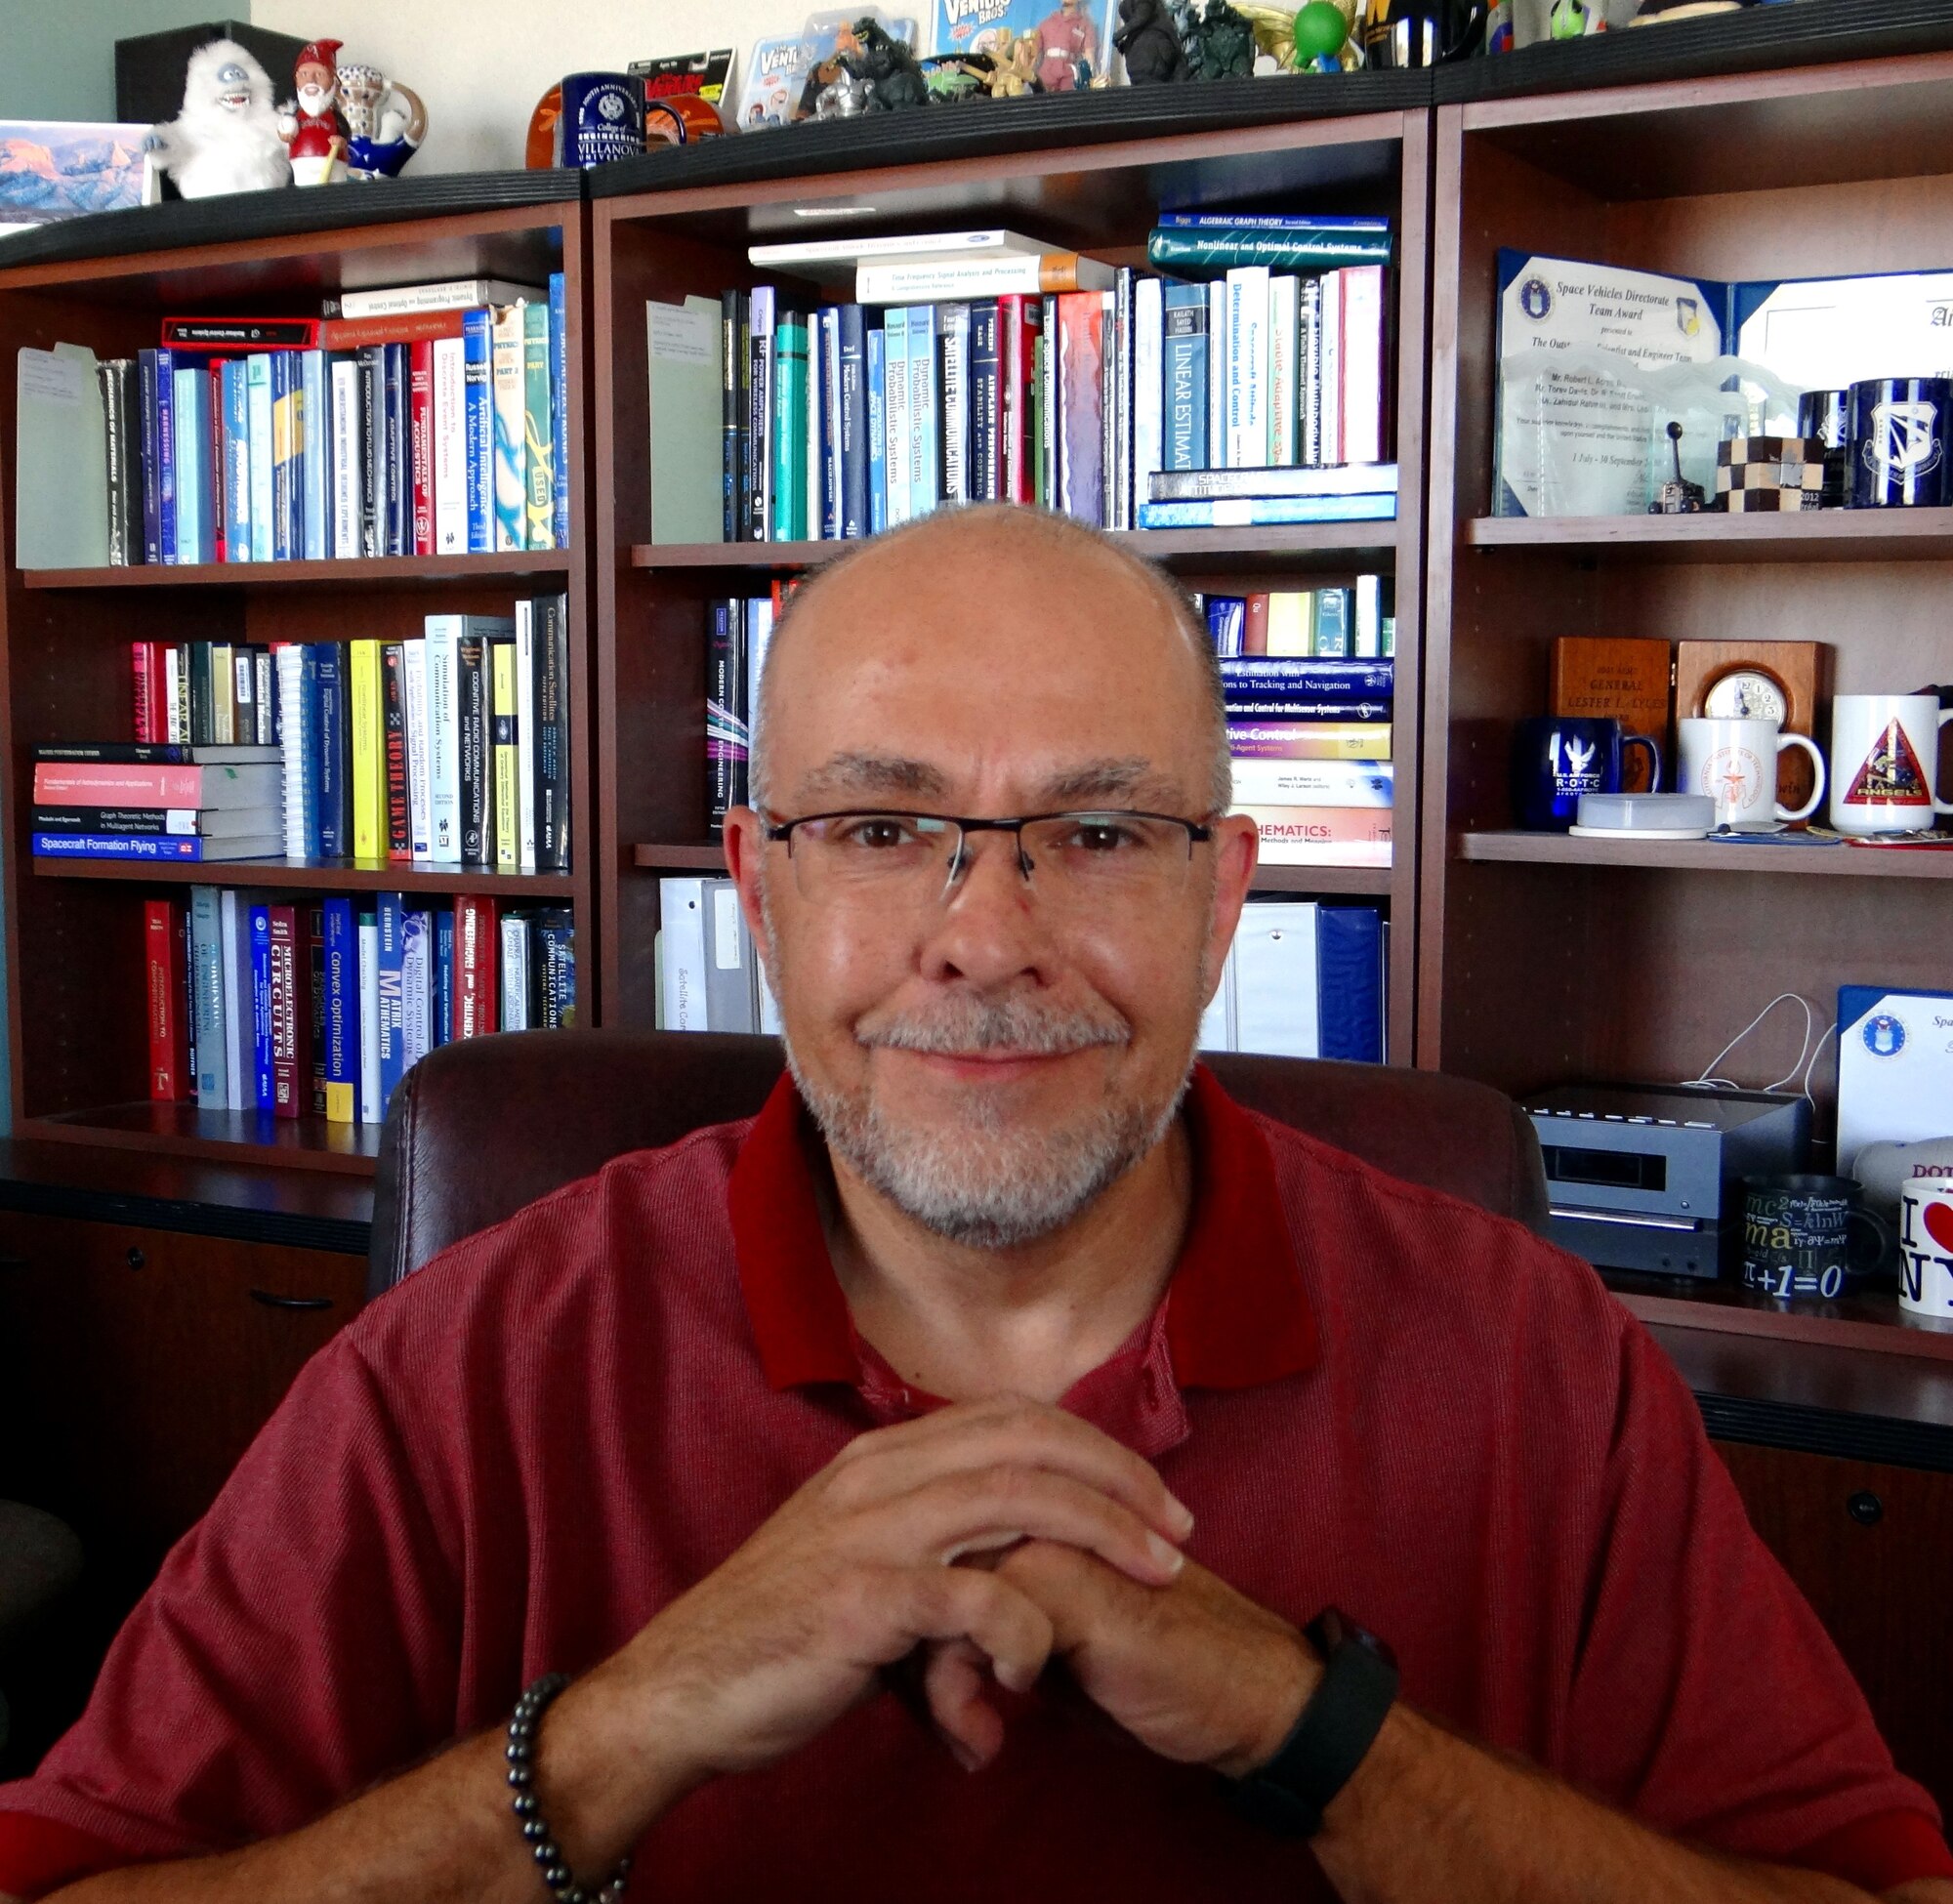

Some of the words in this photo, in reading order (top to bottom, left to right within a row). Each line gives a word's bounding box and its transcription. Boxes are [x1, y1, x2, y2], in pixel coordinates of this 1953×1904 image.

[598, 122, 618, 133] College
[619, 124, 627, 134] of
[1175, 216, 1190, 226] Biggs
[1199, 216, 1233, 226] ALGEBRAIC
[1234, 217, 1257, 227] GRAPH
[1258, 218, 1283, 227] THEORY
[1197, 239, 1238, 251] Nonlinear
[1240, 242, 1254, 251] and
[1257, 241, 1288, 253] Optimal
[1292, 242, 1324, 252] Control
[1327, 243, 1362, 255] Systems
[907, 272, 935, 282] Frequency
[937, 270, 955, 280] Signal
[957, 269, 979, 278] Analysis
[994, 268, 1025, 277] Processing
[1557, 281, 1585, 297] Space
[1587, 285, 1623, 301] Vehicles
[1625, 289, 1670, 307] Directorate
[1043, 315, 1052, 342] Laser
[1231, 283, 1242, 362] Determination
[1590, 304, 1612, 316] Team
[1615, 308, 1643, 320] Award
[759, 340, 768, 357] RF
[1042, 344, 1052, 371] Space
[1532, 336, 1547, 348] The
[1628, 347, 1641, 357] and
[1642, 349, 1674, 361] Engineer
[1675, 352, 1692, 362] Team
[466, 374, 486, 383] Norvig
[921, 359, 930, 408] Dynamic
[943, 336, 959, 392] SATELLITE
[1175, 344, 1192, 399] LINEAR
[1231, 365, 1241, 385] and
[1552, 373, 1561, 382] Mr.
[1564, 374, 1587, 384] Robert
[106, 369, 118, 420] MECHANICS
[843, 393, 852, 419] Control
[888, 361, 897, 431] Probabilistic
[896, 361, 906, 410] Dynamic
[912, 359, 922, 432] Probabilistic
[108, 422, 117, 434] OF
[449, 423, 457, 433] to
[478, 396, 487, 448] Artificial
[1043, 374, 1052, 448] Communications
[1231, 389, 1242, 428] Control
[468, 410, 478, 456] Modern
[842, 421, 851, 452] Systems
[944, 396, 961, 494] COMMUNICATIONS
[1175, 404, 1192, 470] ESTIMAT
[109, 435, 118, 482] MATERIALS
[440, 435, 449, 478] Systems
[888, 434, 897, 484] Systems
[912, 435, 922, 483] Systems
[1578, 453, 1593, 465] July
[1600, 454, 1608, 463] 30
[1610, 454, 1642, 468] September
[467, 459, 478, 511] Approach
[478, 451, 488, 516] Intelligence
[534, 470, 546, 502] USED
[1801, 492, 1819, 502] 2012
[547, 606, 556, 681] Communication
[434, 654, 442, 736] Communication
[548, 682, 558, 721] Satellites
[1239, 681, 1248, 689] to
[1250, 680, 1285, 691] Tracking
[1287, 681, 1303, 689] and
[1305, 681, 1350, 691] Navigation
[1568, 696, 1610, 708] LESTER
[1633, 697, 1667, 709] LYLES
[1591, 680, 1642, 691] GENERAL
[442, 713, 450, 723] of
[1249, 728, 1296, 741] Control
[388, 731, 404, 787] THEORY
[434, 739, 442, 780] Systems
[717, 740, 726, 799] ENGINEERING
[472, 745, 480, 823] COMMUNICATIONS
[101, 811, 117, 820] Graph
[106, 822, 134, 831] Multiagent
[391, 789, 406, 839] GAME
[41, 837, 85, 850] Spacecraft
[87, 839, 129, 849] Formation
[130, 840, 156, 853] Flying
[465, 908, 476, 969] ENGINEERING
[330, 951, 342, 995] Convex
[405, 957, 414, 1007] Dynamic
[414, 957, 425, 994] Digital
[465, 974, 475, 989] and
[547, 933, 558, 1029] COMMUNICATIONS
[558, 943, 567, 1000] SATELLITE
[678, 968, 688, 1010] Satellite
[271, 944, 283, 1057] CIRCUITS
[283, 945, 294, 1058] MICROELECTRONIC
[415, 998, 424, 1039] Control
[463, 992, 476, 1039] CIENTIFIC,
[330, 998, 345, 1077] Optimization
[405, 1010, 414, 1055] Systems
[415, 1042, 425, 1055] of
[1901, 1196, 1919, 1248] I
